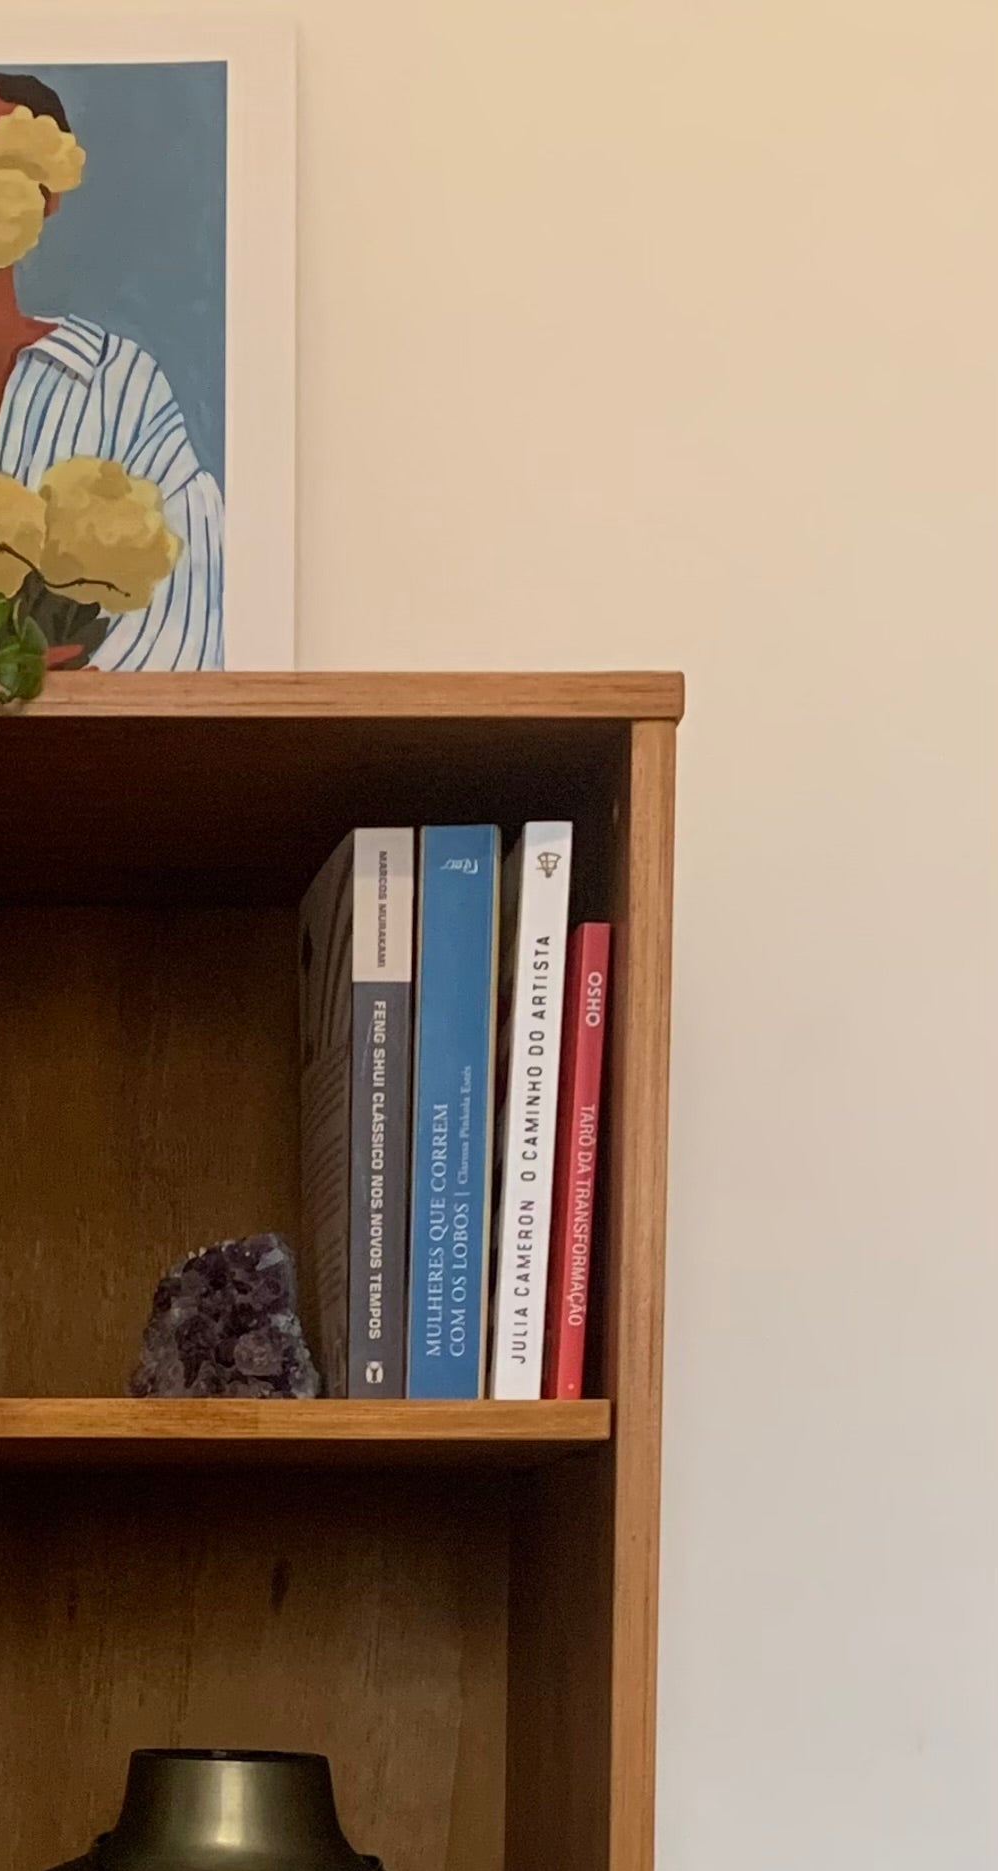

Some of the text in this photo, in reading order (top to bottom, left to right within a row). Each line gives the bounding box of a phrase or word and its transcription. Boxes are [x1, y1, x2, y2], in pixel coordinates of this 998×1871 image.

[376, 850, 388, 969] MARCOS MURAKAMI
[585, 971, 603, 1028] OSHO
[520, 936, 551, 1182] O CAMINHO DO ARTISTA
[368, 1000, 387, 1340] FENG SHUI CLÁSSICO NOS NOVOS TEMPOS
[425, 1103, 449, 1357] MULHERES QUE CORREM
[567, 1104, 597, 1327] TARÔ DA TRANSFORMAÇÃO
[449, 1203, 470, 1358] COM OS LOBOS
[510, 1200, 535, 1365] JULIA CAMERON
